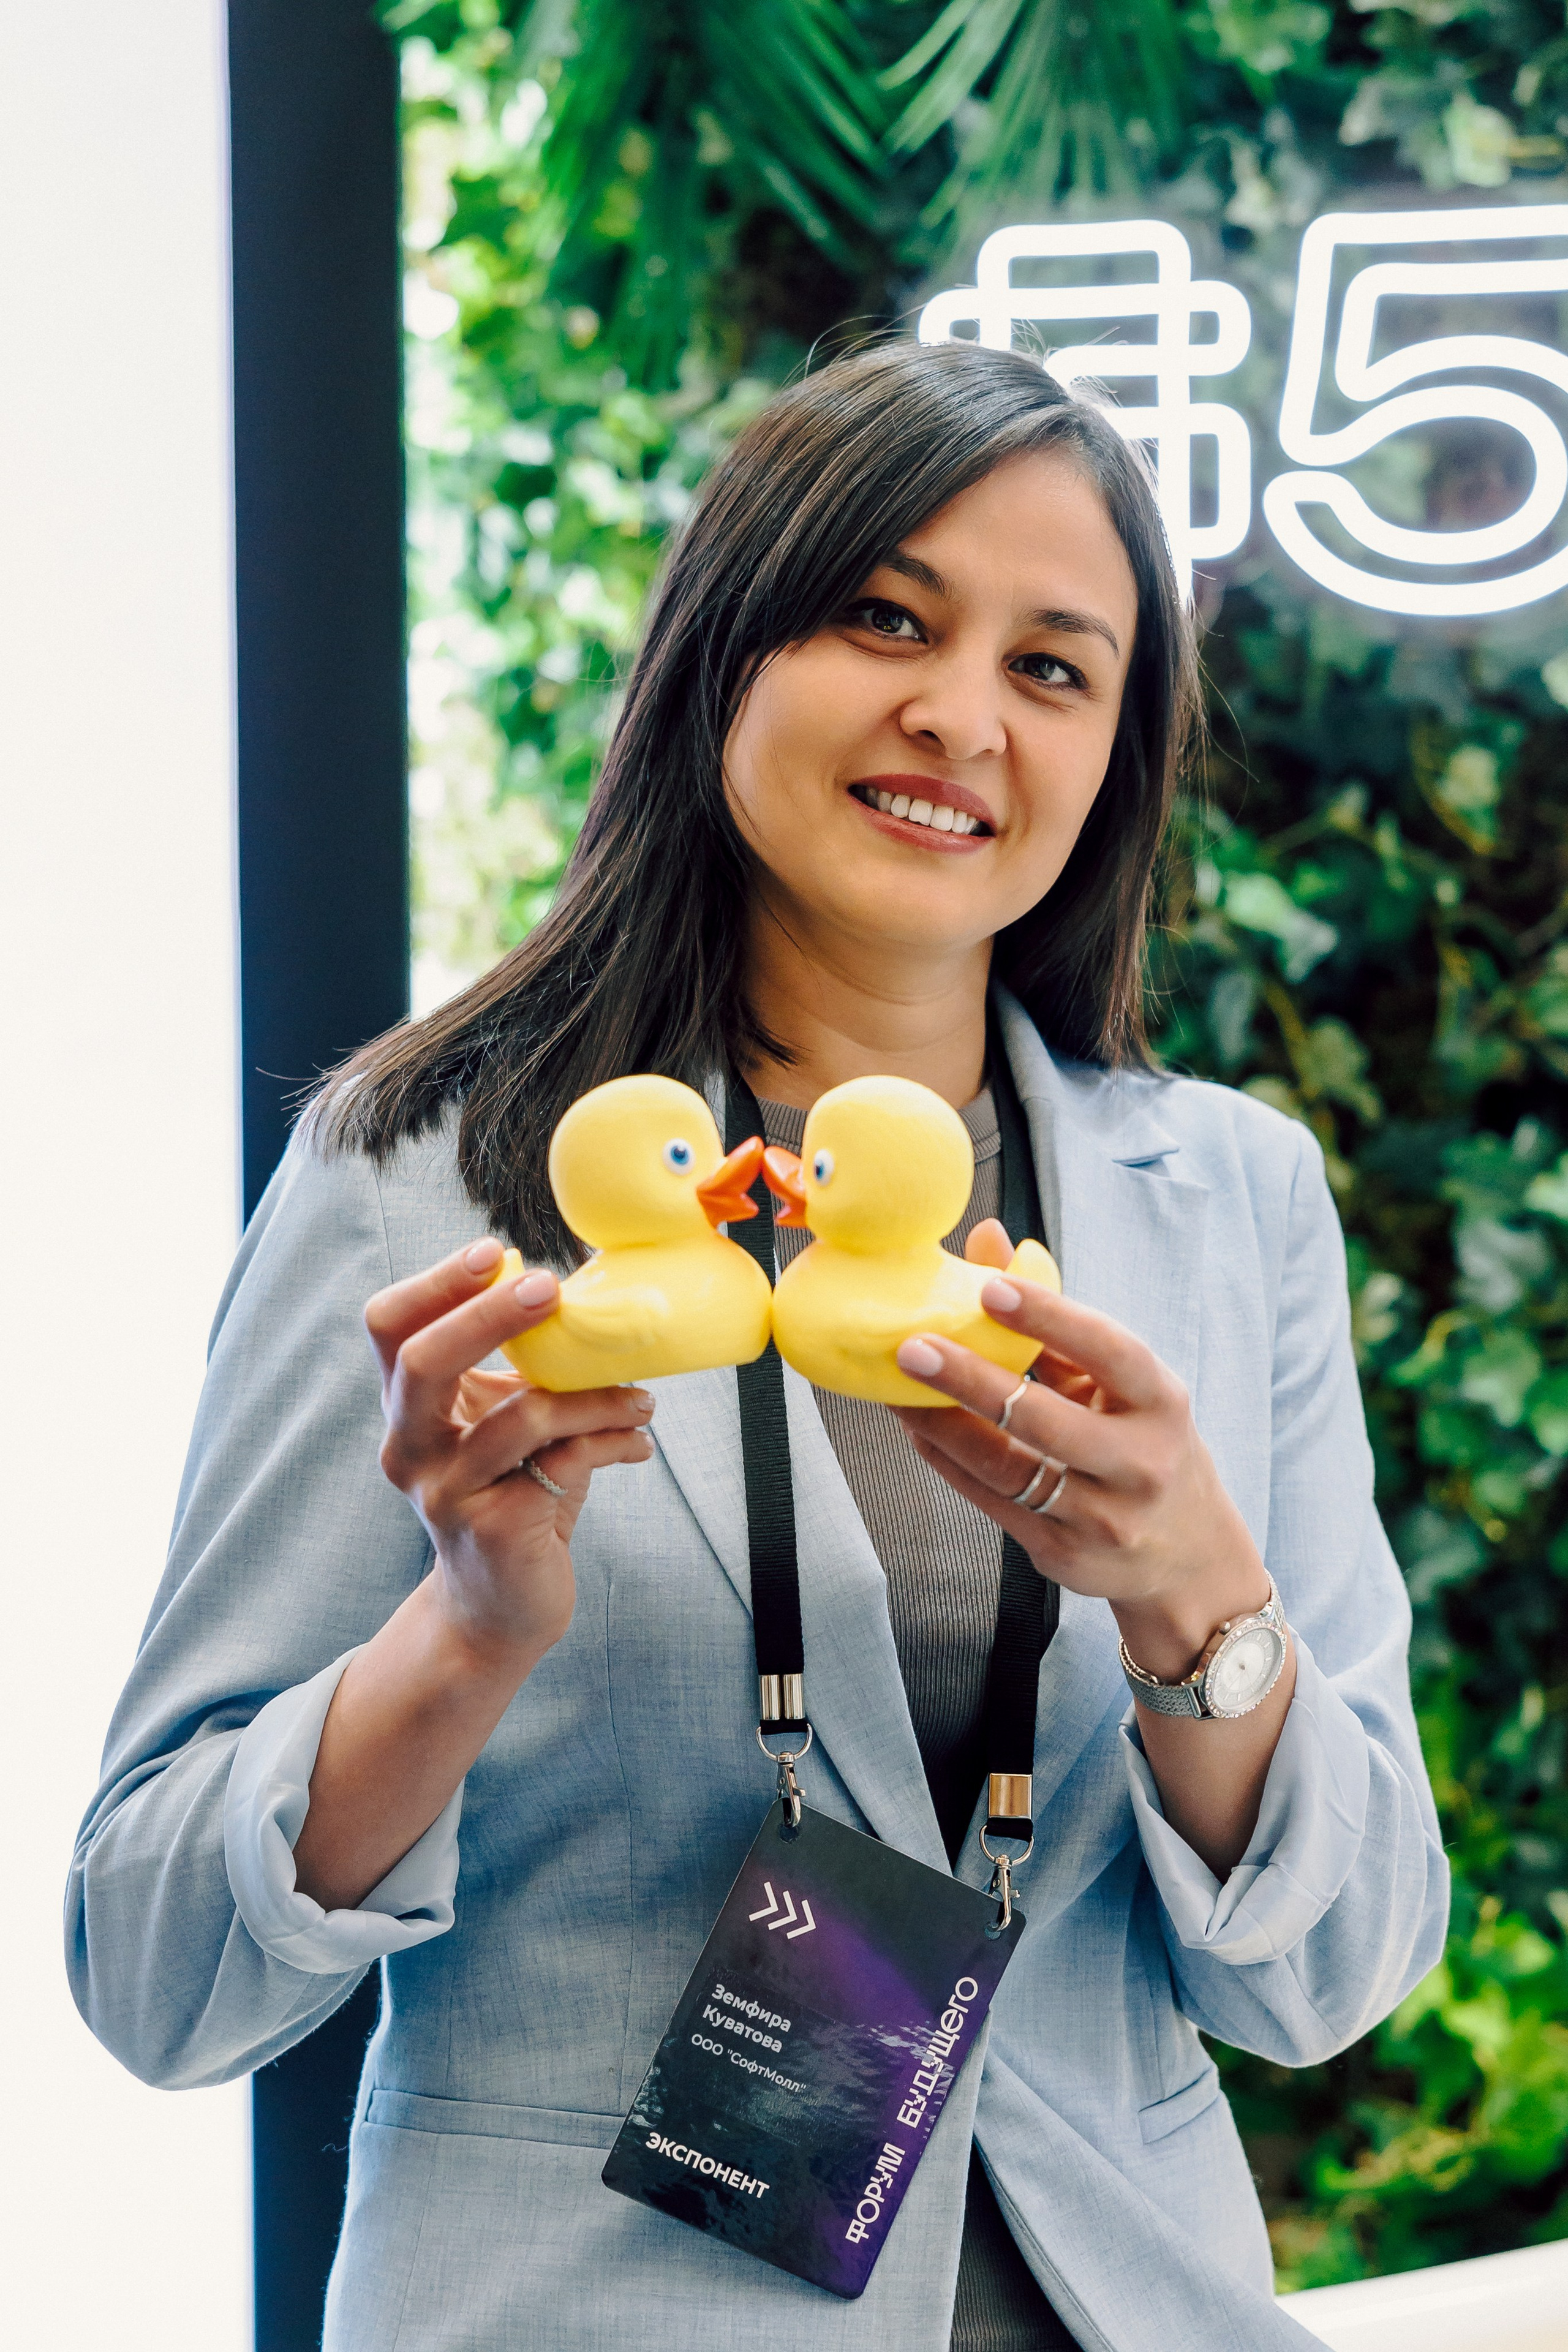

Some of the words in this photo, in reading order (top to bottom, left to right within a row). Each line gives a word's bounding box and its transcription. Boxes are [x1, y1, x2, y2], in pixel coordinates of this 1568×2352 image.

[703, 2004, 783, 2053] Куватова
[711, 1983, 791, 2032] Земфира
[691, 2034, 723, 2056] ООО
[727, 2048, 807, 2093] "СофтМолл"
[645, 2132, 770, 2199] ЭКСПОНЕНТ
[845, 2143, 905, 2244] ФОРУМ
